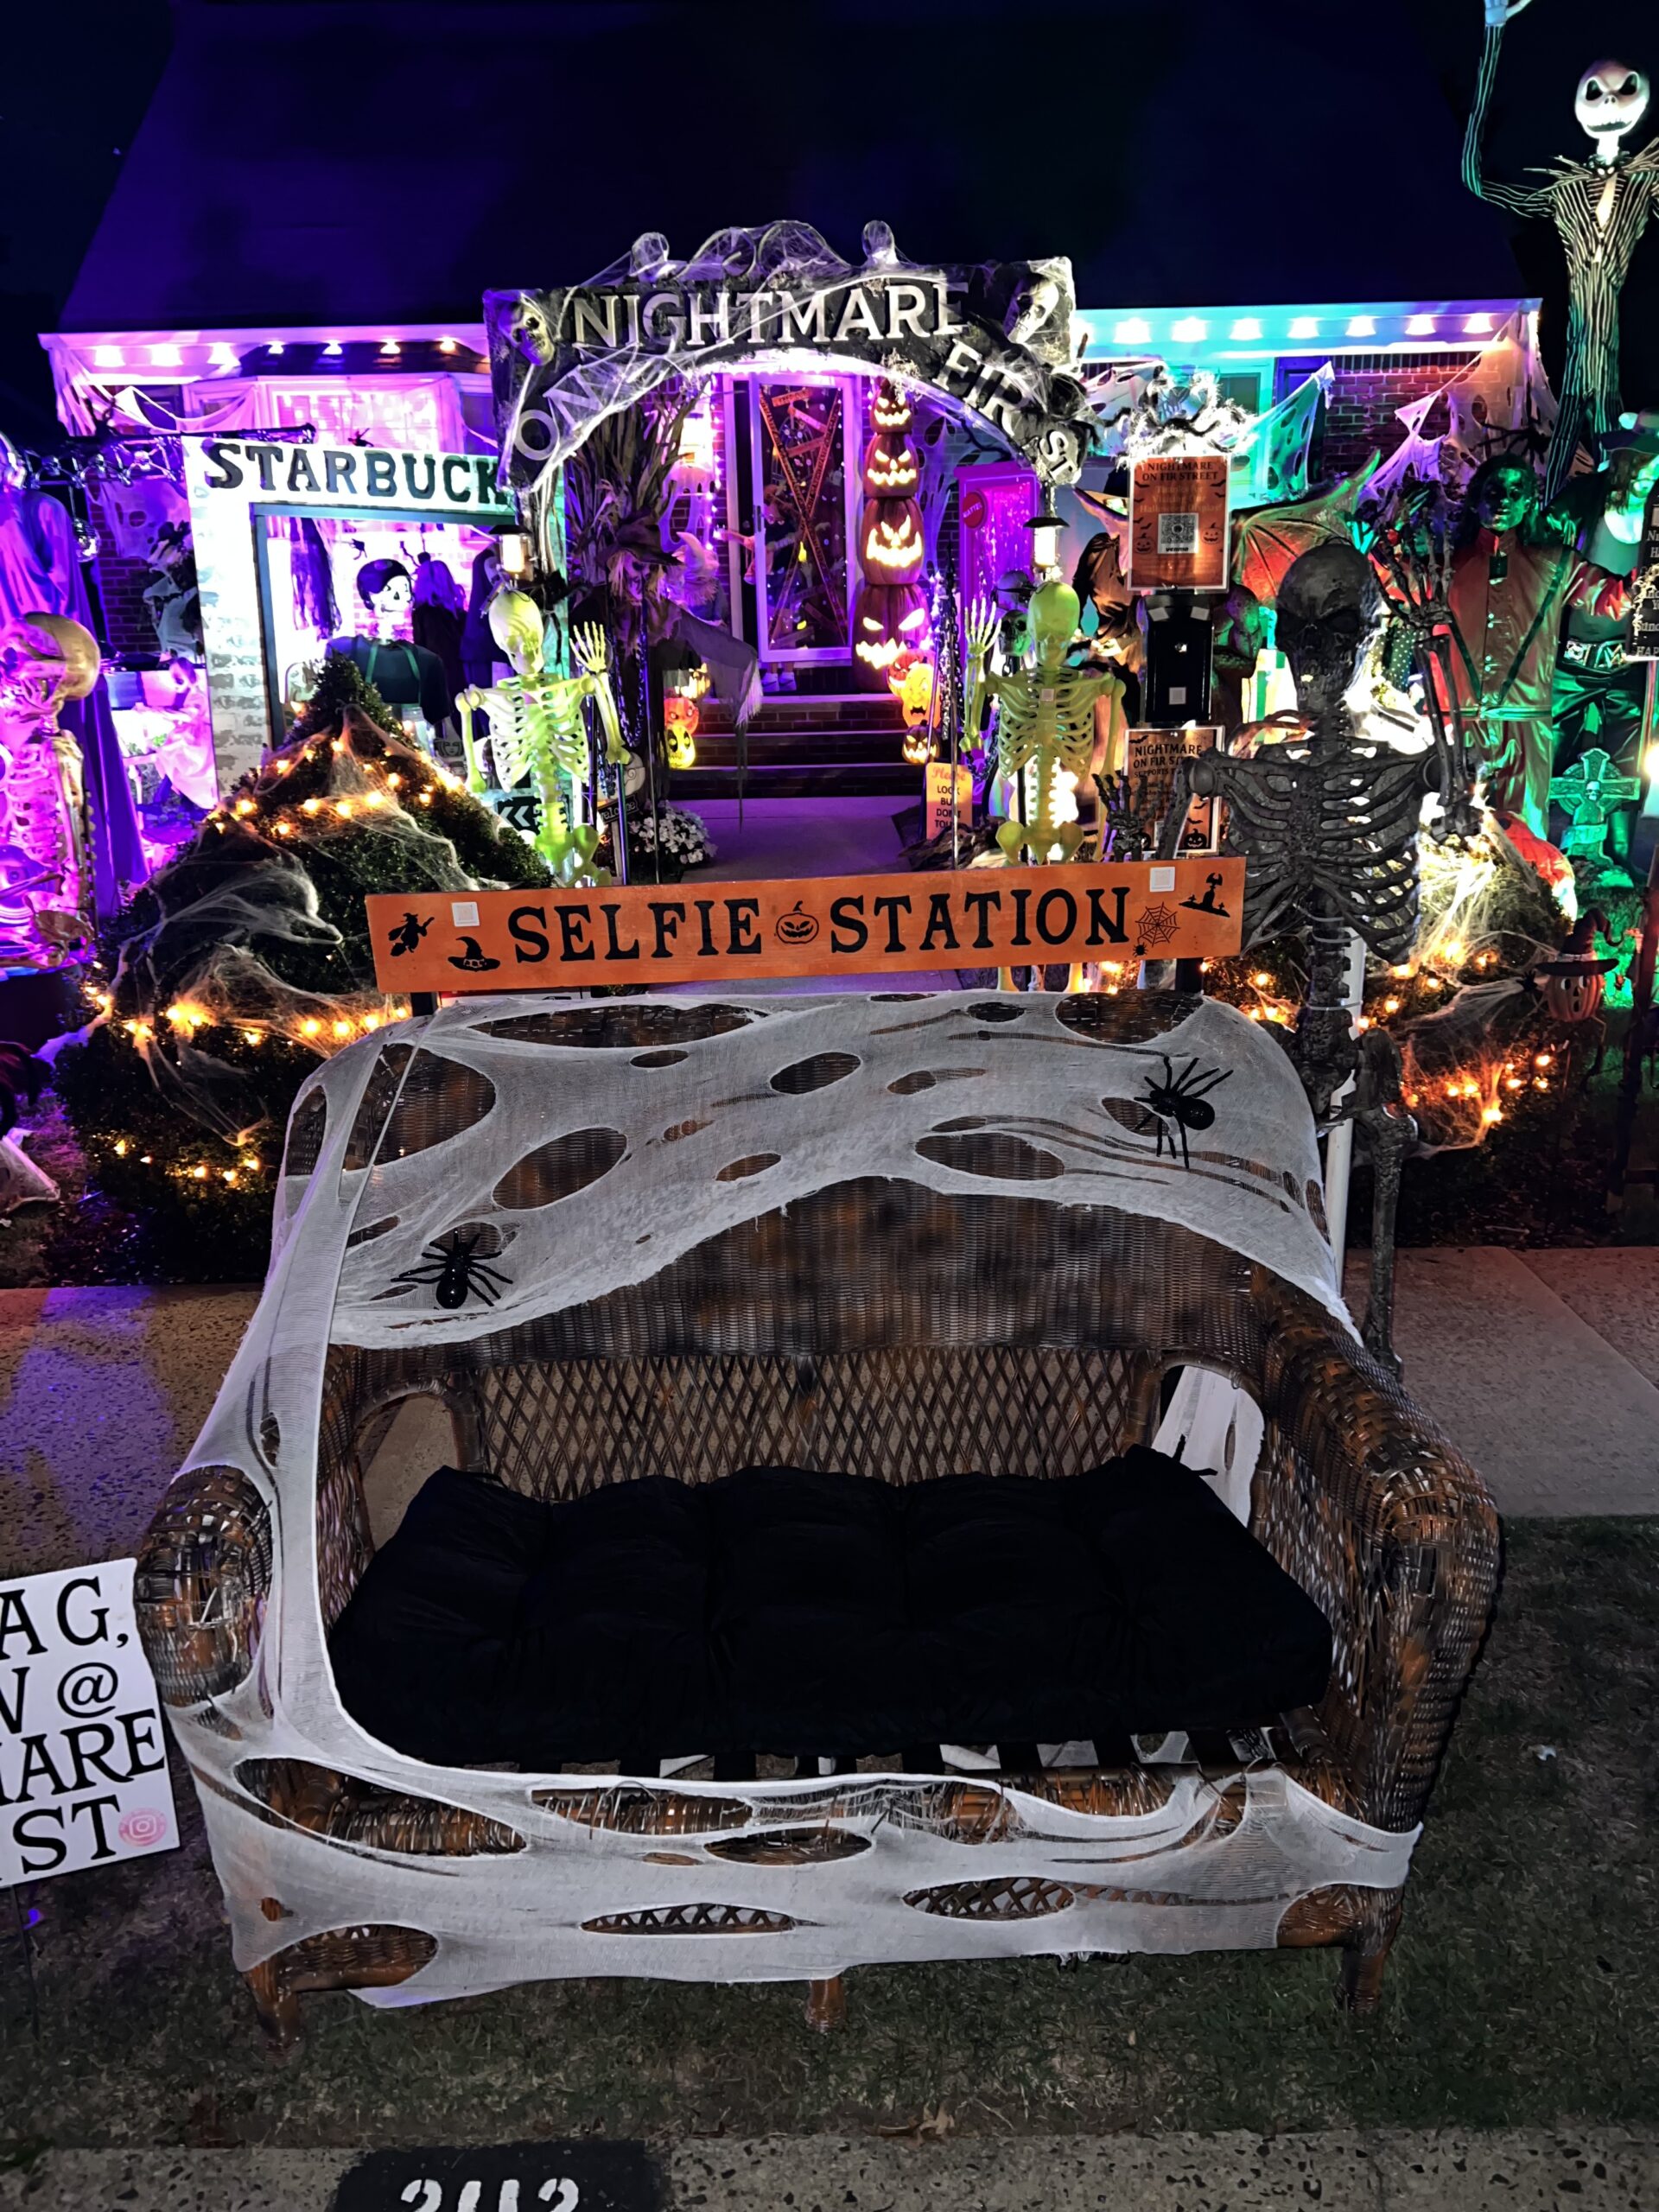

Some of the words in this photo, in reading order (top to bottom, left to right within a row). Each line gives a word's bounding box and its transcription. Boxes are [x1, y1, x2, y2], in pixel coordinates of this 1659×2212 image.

[572, 282, 969, 347] NIGHTMARE
[513, 365, 607, 461] ON
[931, 339, 1031, 436] FIR
[1147, 461, 1213, 472] NIGHTMARE
[1160, 472, 1177, 481] FIR
[1179, 471, 1218, 480] STREET
[1134, 759, 1147, 769] ON
[1150, 756, 1166, 767] FIR
[1135, 743, 1202, 757] NIGHTMARE
[507, 898, 762, 963] SELFIE
[830, 887, 1130, 953] STATION
[0, 1708, 165, 1806] ARE
